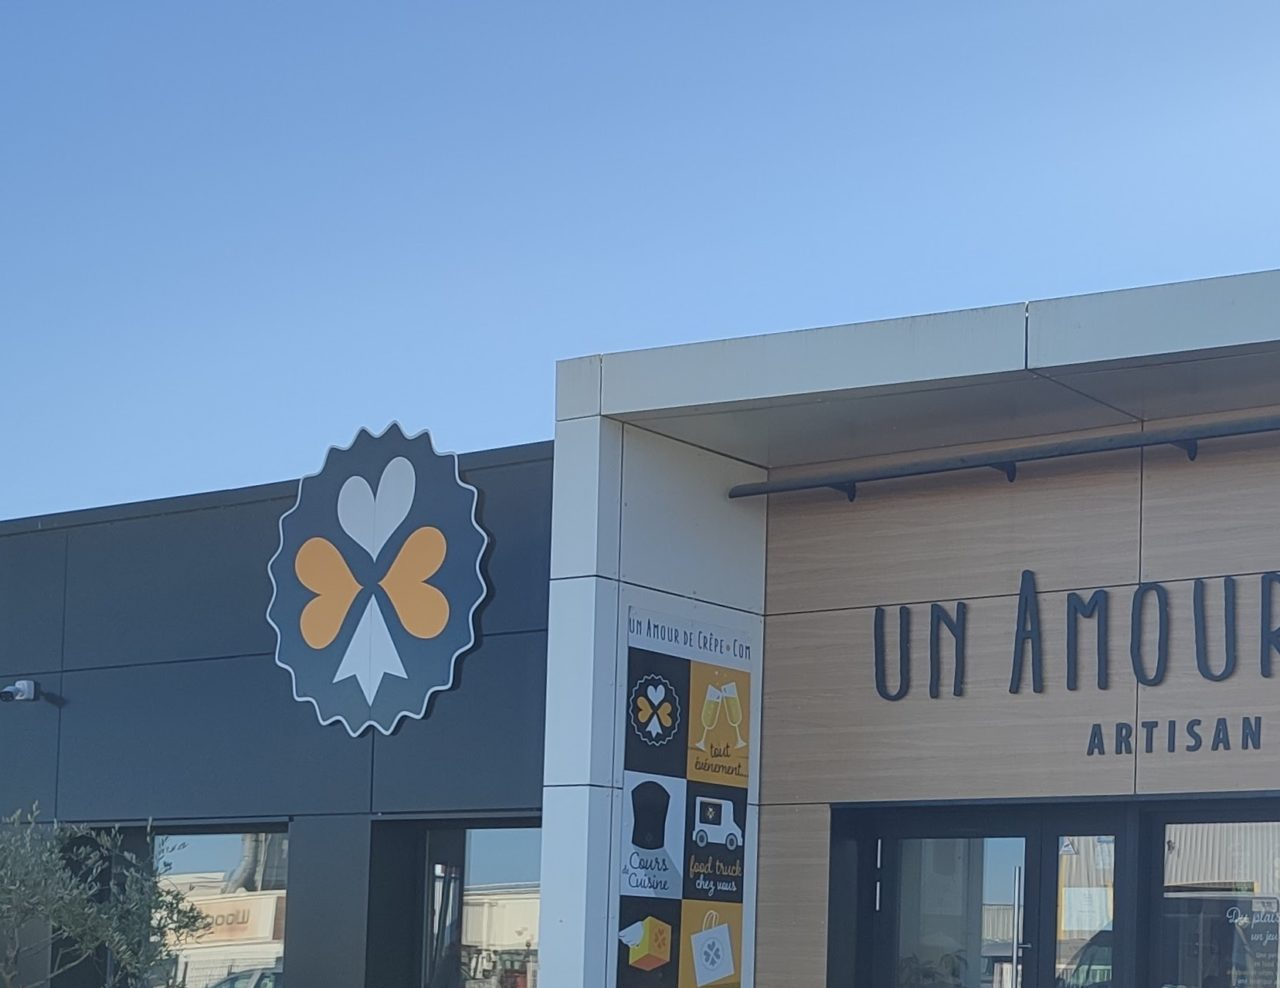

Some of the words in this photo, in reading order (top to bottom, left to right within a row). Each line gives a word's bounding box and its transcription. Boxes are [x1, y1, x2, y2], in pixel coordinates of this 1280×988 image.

[629, 617, 642, 635] UN
[646, 618, 680, 646] AMOUR
[683, 630, 694, 648] DE
[873, 600, 968, 701] UN
[1086, 715, 1262, 756] ARTISAN
[711, 743, 731, 758] tout
[629, 852, 669, 871] Cours
[689, 855, 713, 878] food
[715, 857, 742, 877] truck
[628, 872, 669, 890] Cuisine
[696, 875, 715, 896] chez
[716, 881, 737, 891] vous
